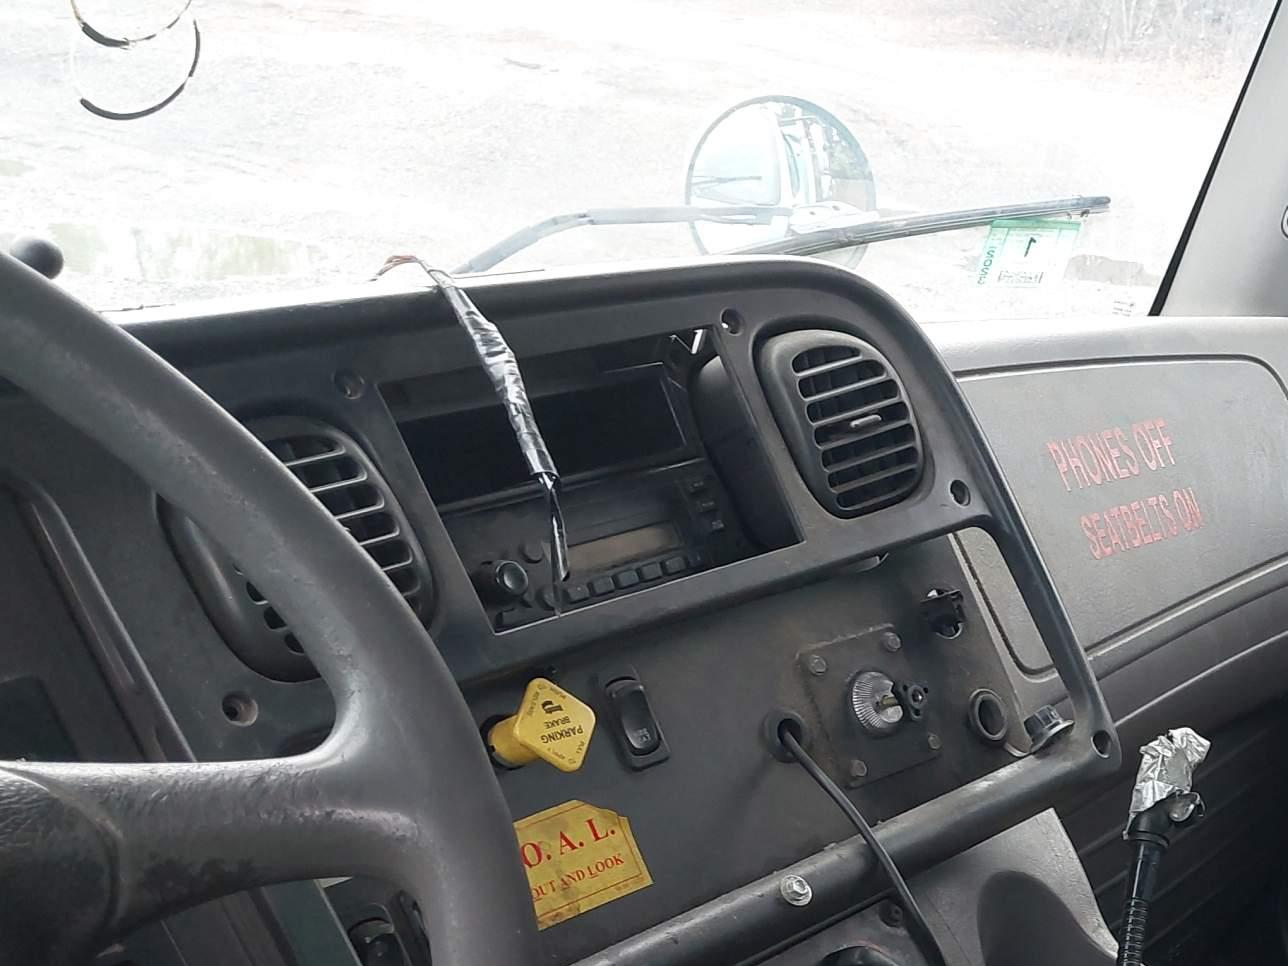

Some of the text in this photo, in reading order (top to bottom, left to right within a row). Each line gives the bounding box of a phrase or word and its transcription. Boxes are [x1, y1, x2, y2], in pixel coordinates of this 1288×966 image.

[1046, 416, 1175, 492] PHONES OFF
[1079, 487, 1206, 560] SEATBELTS ON
[542, 724, 584, 745] PARKING
[545, 715, 571, 730] BRAKE
[558, 830, 584, 856] A.
[586, 817, 616, 843] L.
[559, 868, 586, 890] AND
[588, 852, 625, 878] LOOK
